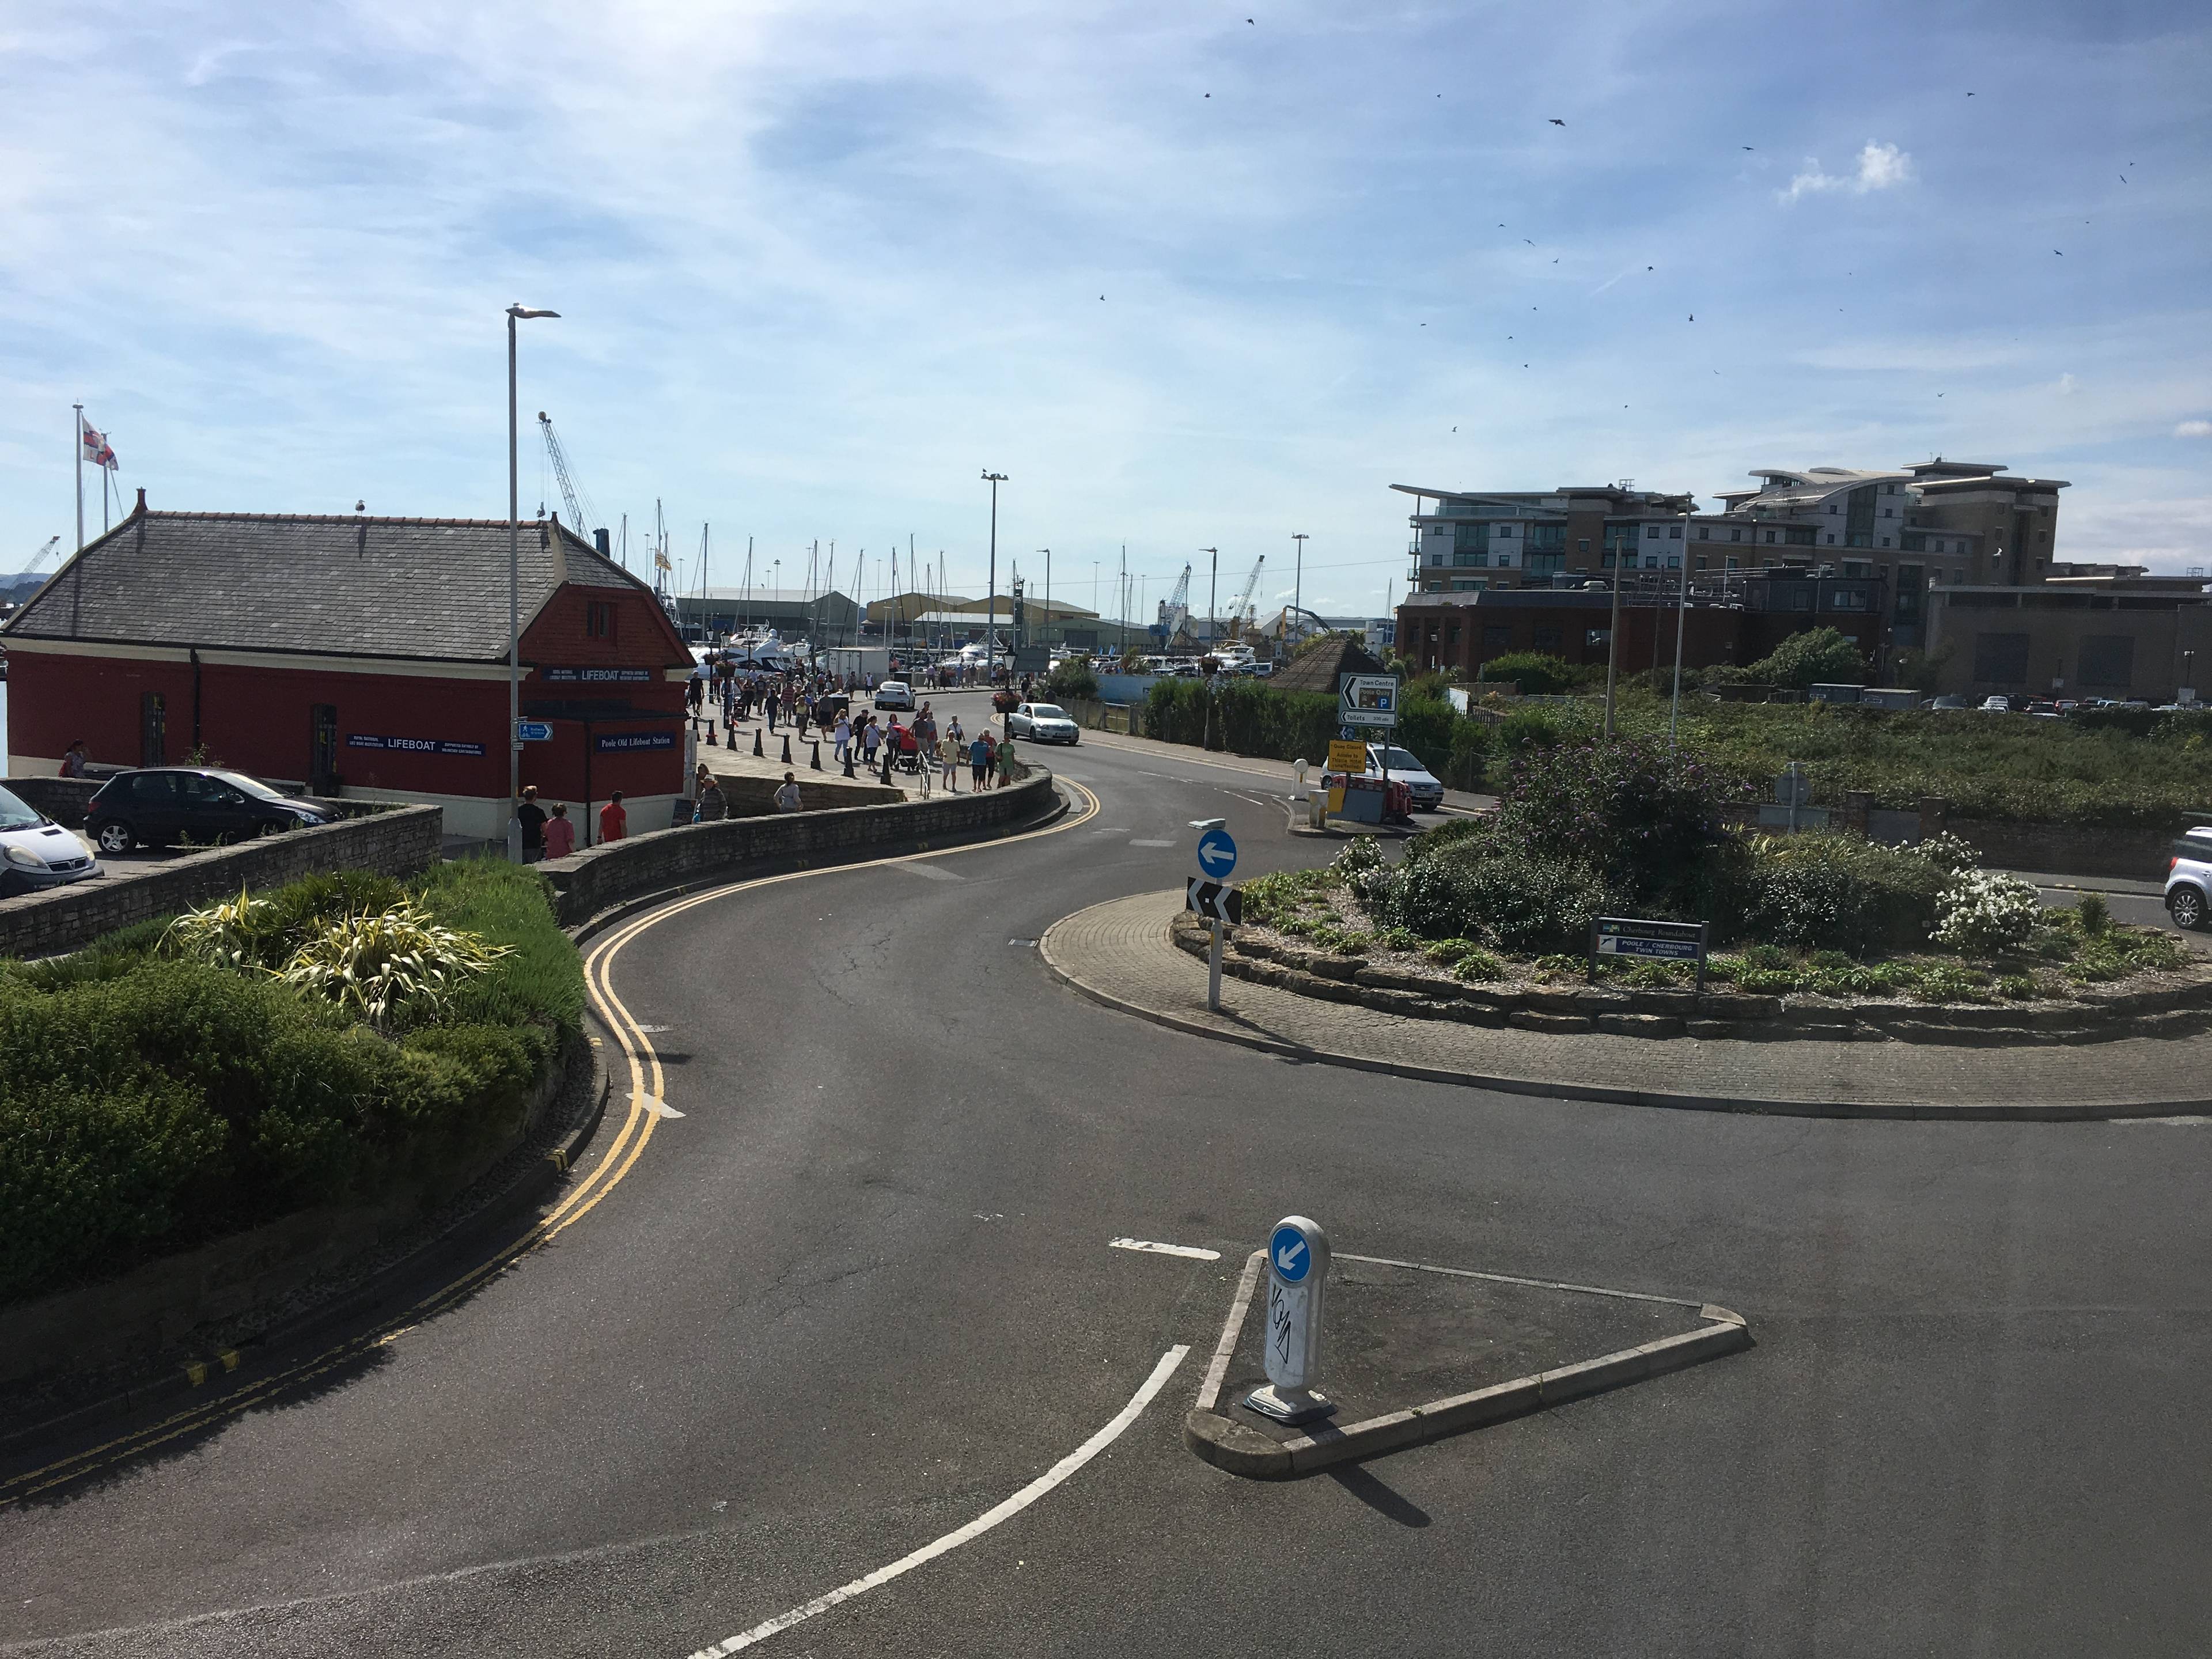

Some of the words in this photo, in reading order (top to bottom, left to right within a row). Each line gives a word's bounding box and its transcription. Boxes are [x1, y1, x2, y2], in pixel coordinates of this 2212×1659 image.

[582, 670, 619, 680] LIFEBOAT
[1380, 698, 1387, 707] P
[388, 738, 436, 751] LIFEBOAT
[601, 739, 616, 748] Poole
[618, 738, 627, 746] Old
[630, 737, 650, 746] Lifeboat
[653, 736, 670, 745] Station
[1623, 926, 1655, 936] Cherbourg
[1658, 929, 1696, 938] Roundabout
[1652, 942, 1693, 951] CHERBOURG
